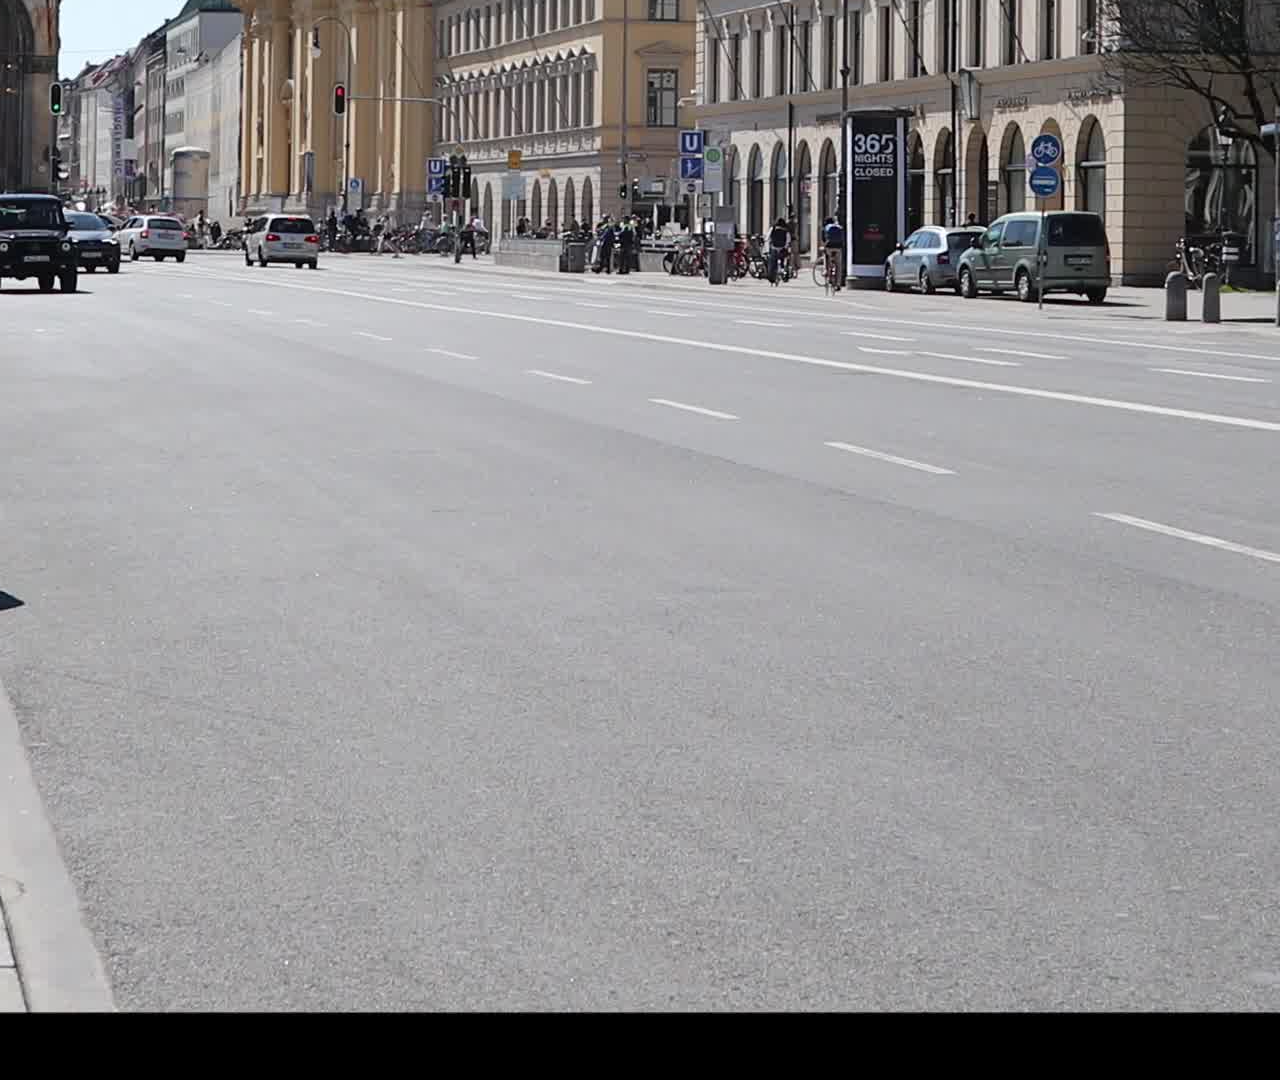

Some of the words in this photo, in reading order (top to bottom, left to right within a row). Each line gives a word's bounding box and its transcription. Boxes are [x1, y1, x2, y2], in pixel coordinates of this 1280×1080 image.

[686, 135, 697, 150] U
[854, 134, 894, 153] 365
[855, 154, 894, 163] NIGHTS
[431, 161, 440, 172] U
[854, 168, 894, 177] CLOSED
